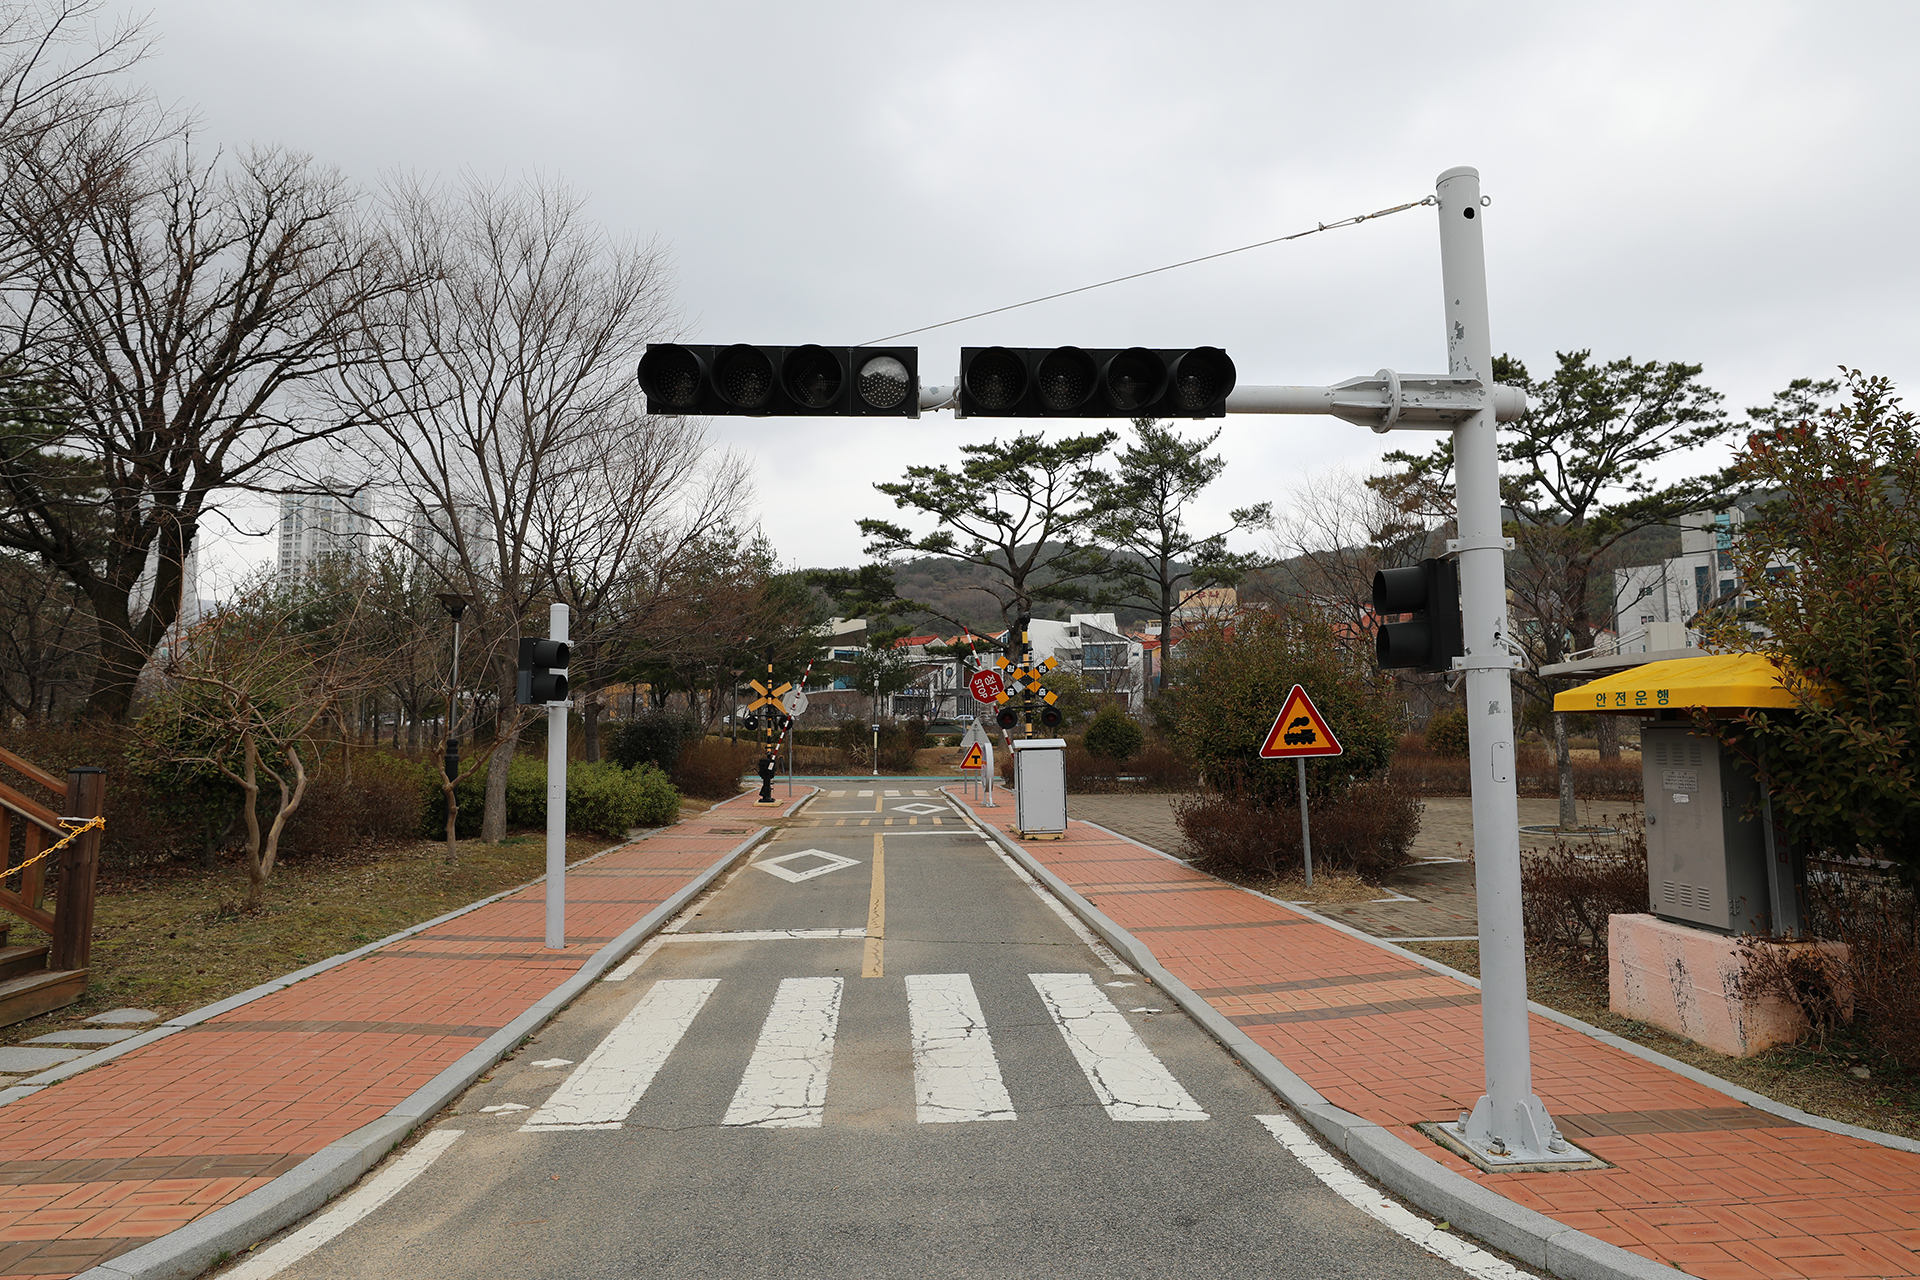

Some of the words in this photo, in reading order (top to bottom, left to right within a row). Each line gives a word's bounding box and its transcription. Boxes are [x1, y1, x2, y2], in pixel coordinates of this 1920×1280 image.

[974, 678, 988, 698] STOP
[984, 674, 1001, 697] 정지
[1595, 689, 1669, 708] 안전운행
